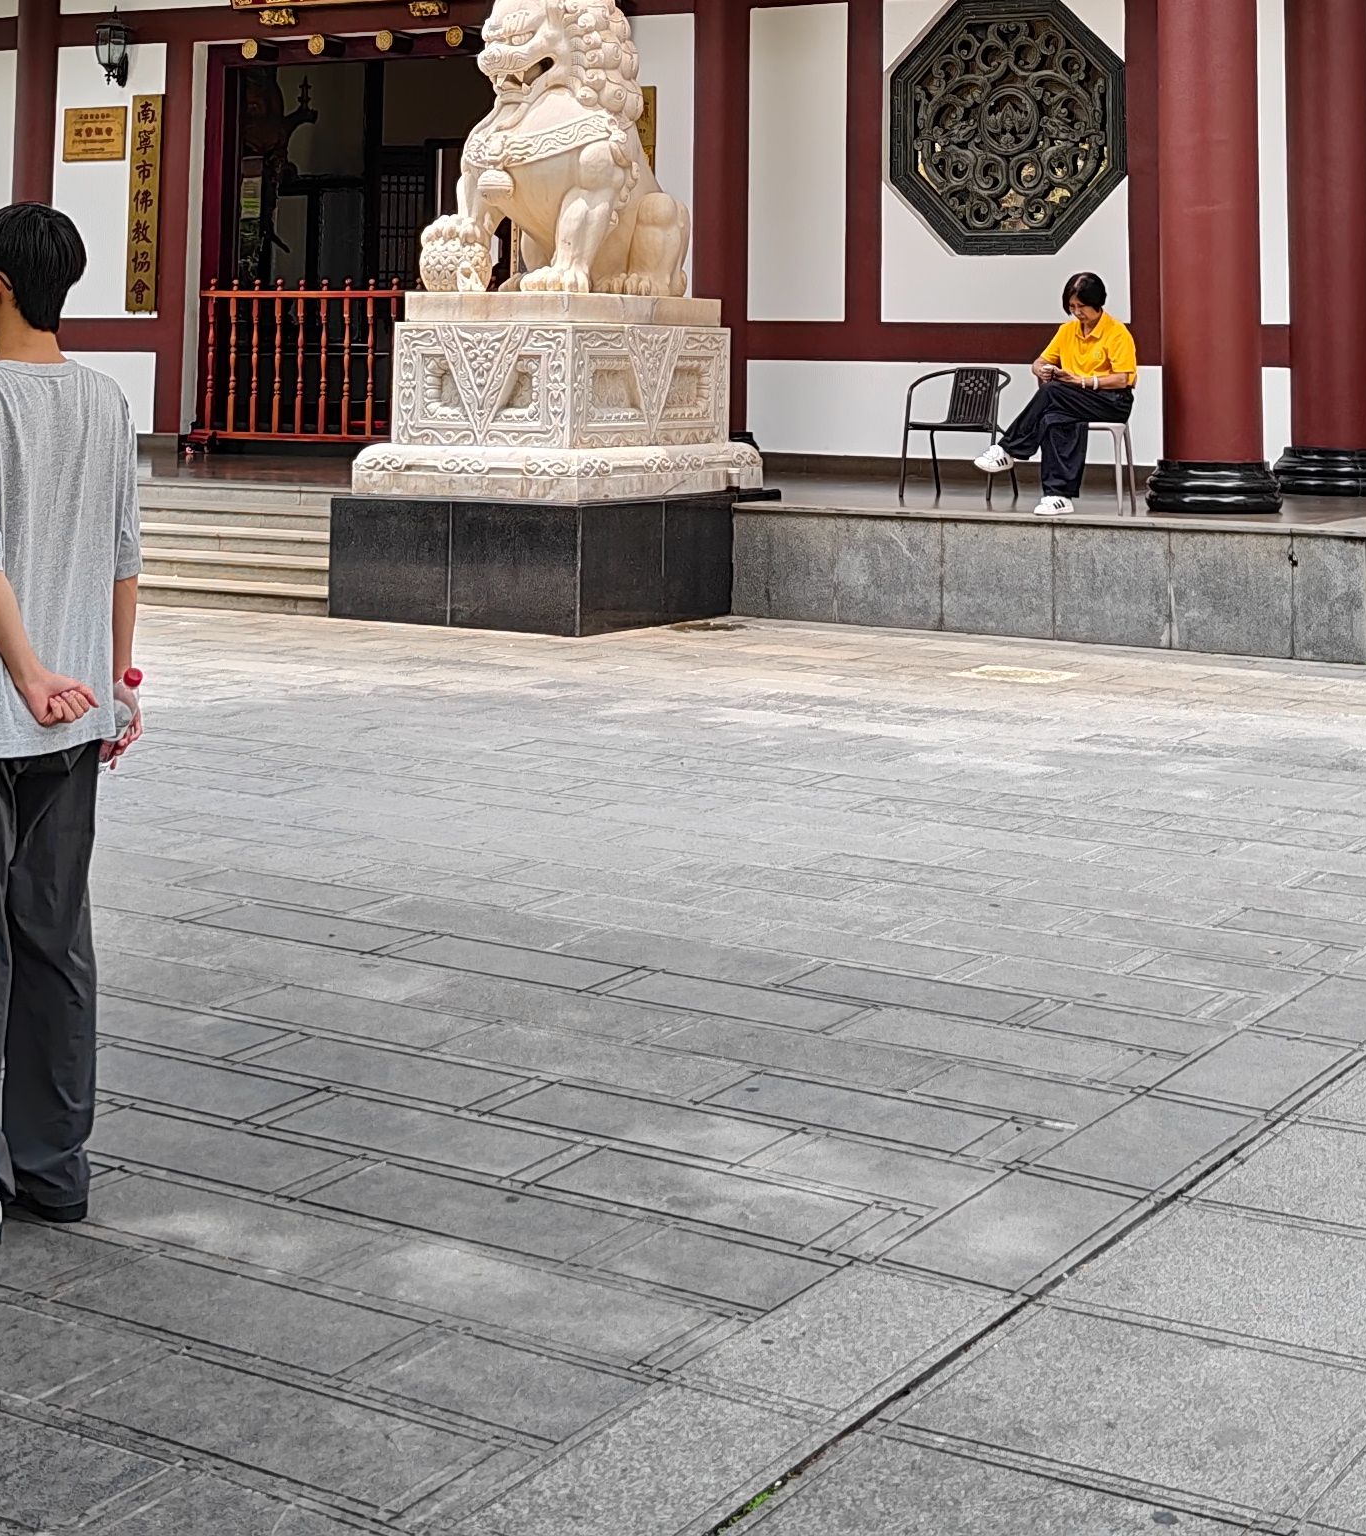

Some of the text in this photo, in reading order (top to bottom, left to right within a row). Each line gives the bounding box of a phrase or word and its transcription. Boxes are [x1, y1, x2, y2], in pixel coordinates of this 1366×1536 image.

[130, 100, 157, 305] 南寧市佛教協會
